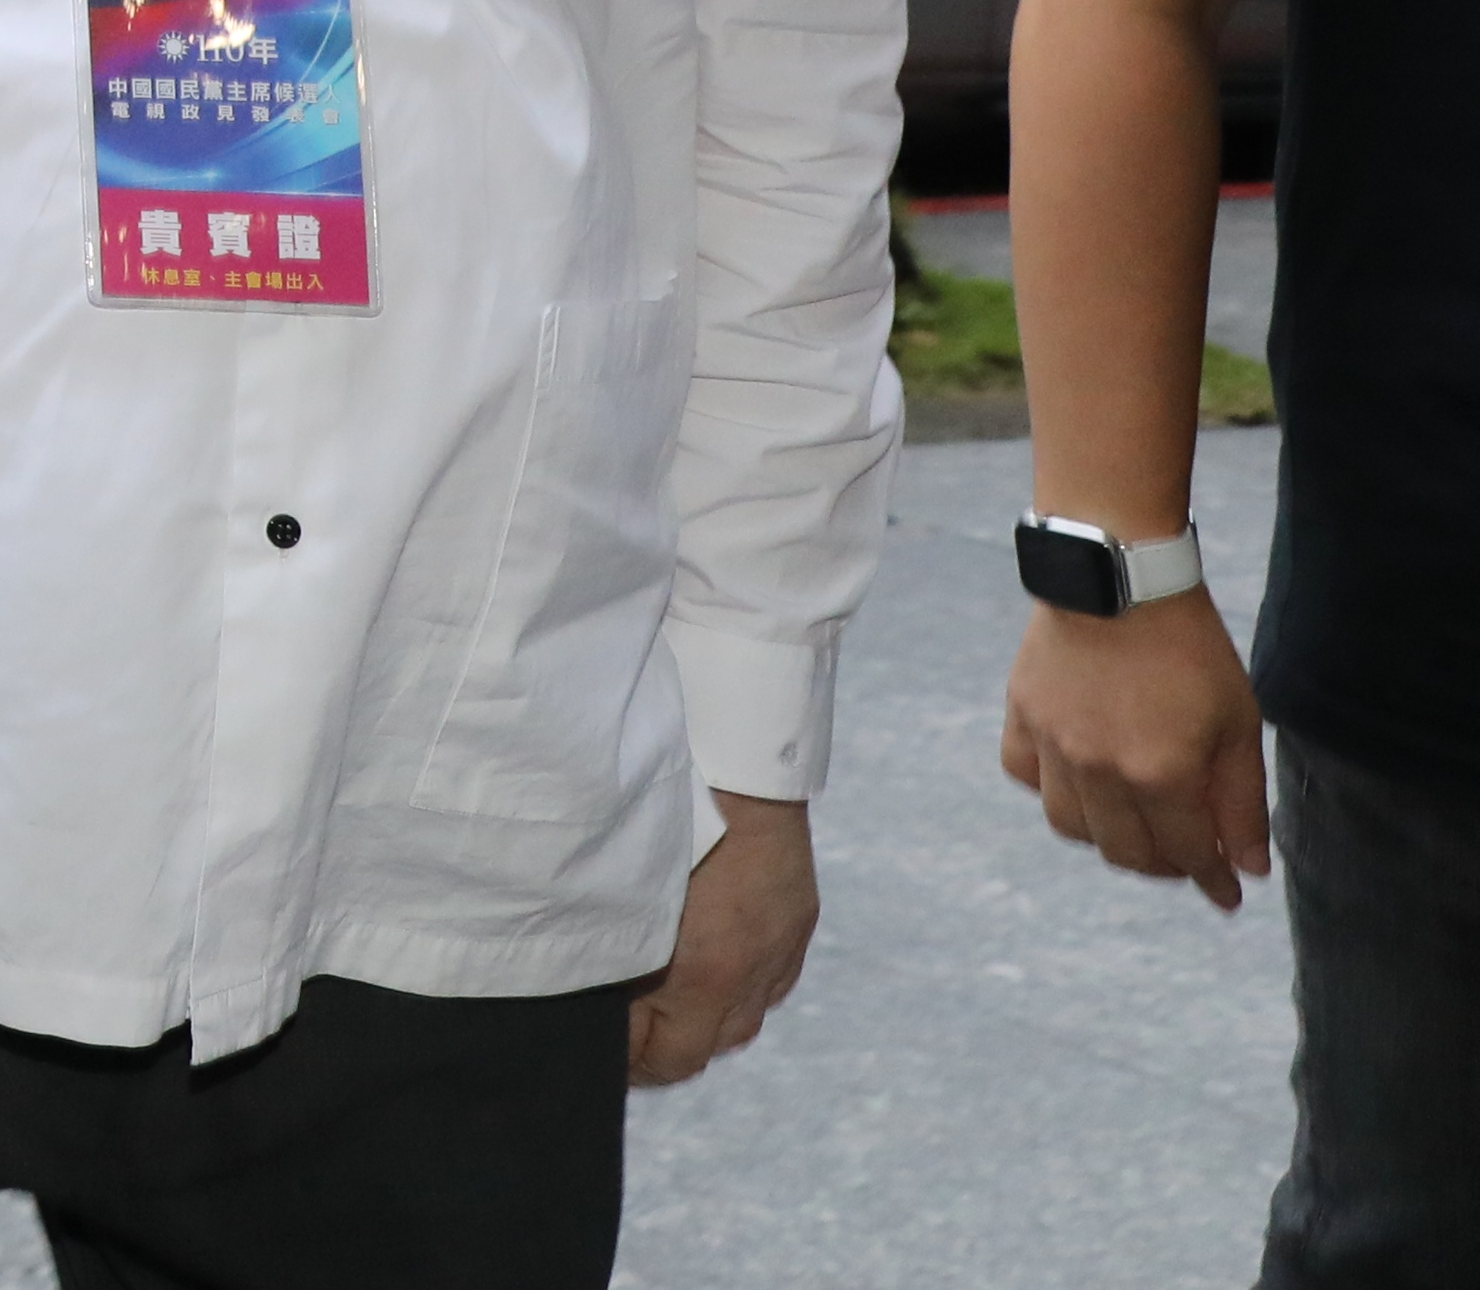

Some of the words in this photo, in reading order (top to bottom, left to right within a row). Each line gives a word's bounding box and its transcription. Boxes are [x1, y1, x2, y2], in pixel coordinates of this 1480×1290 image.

[108, 77, 340, 105] 中國國民黨主席候選人
[111, 102, 341, 126] 電視政見發表會
[138, 208, 322, 261] 貴賓證
[143, 267, 324, 292] 休息室、主會場出入
